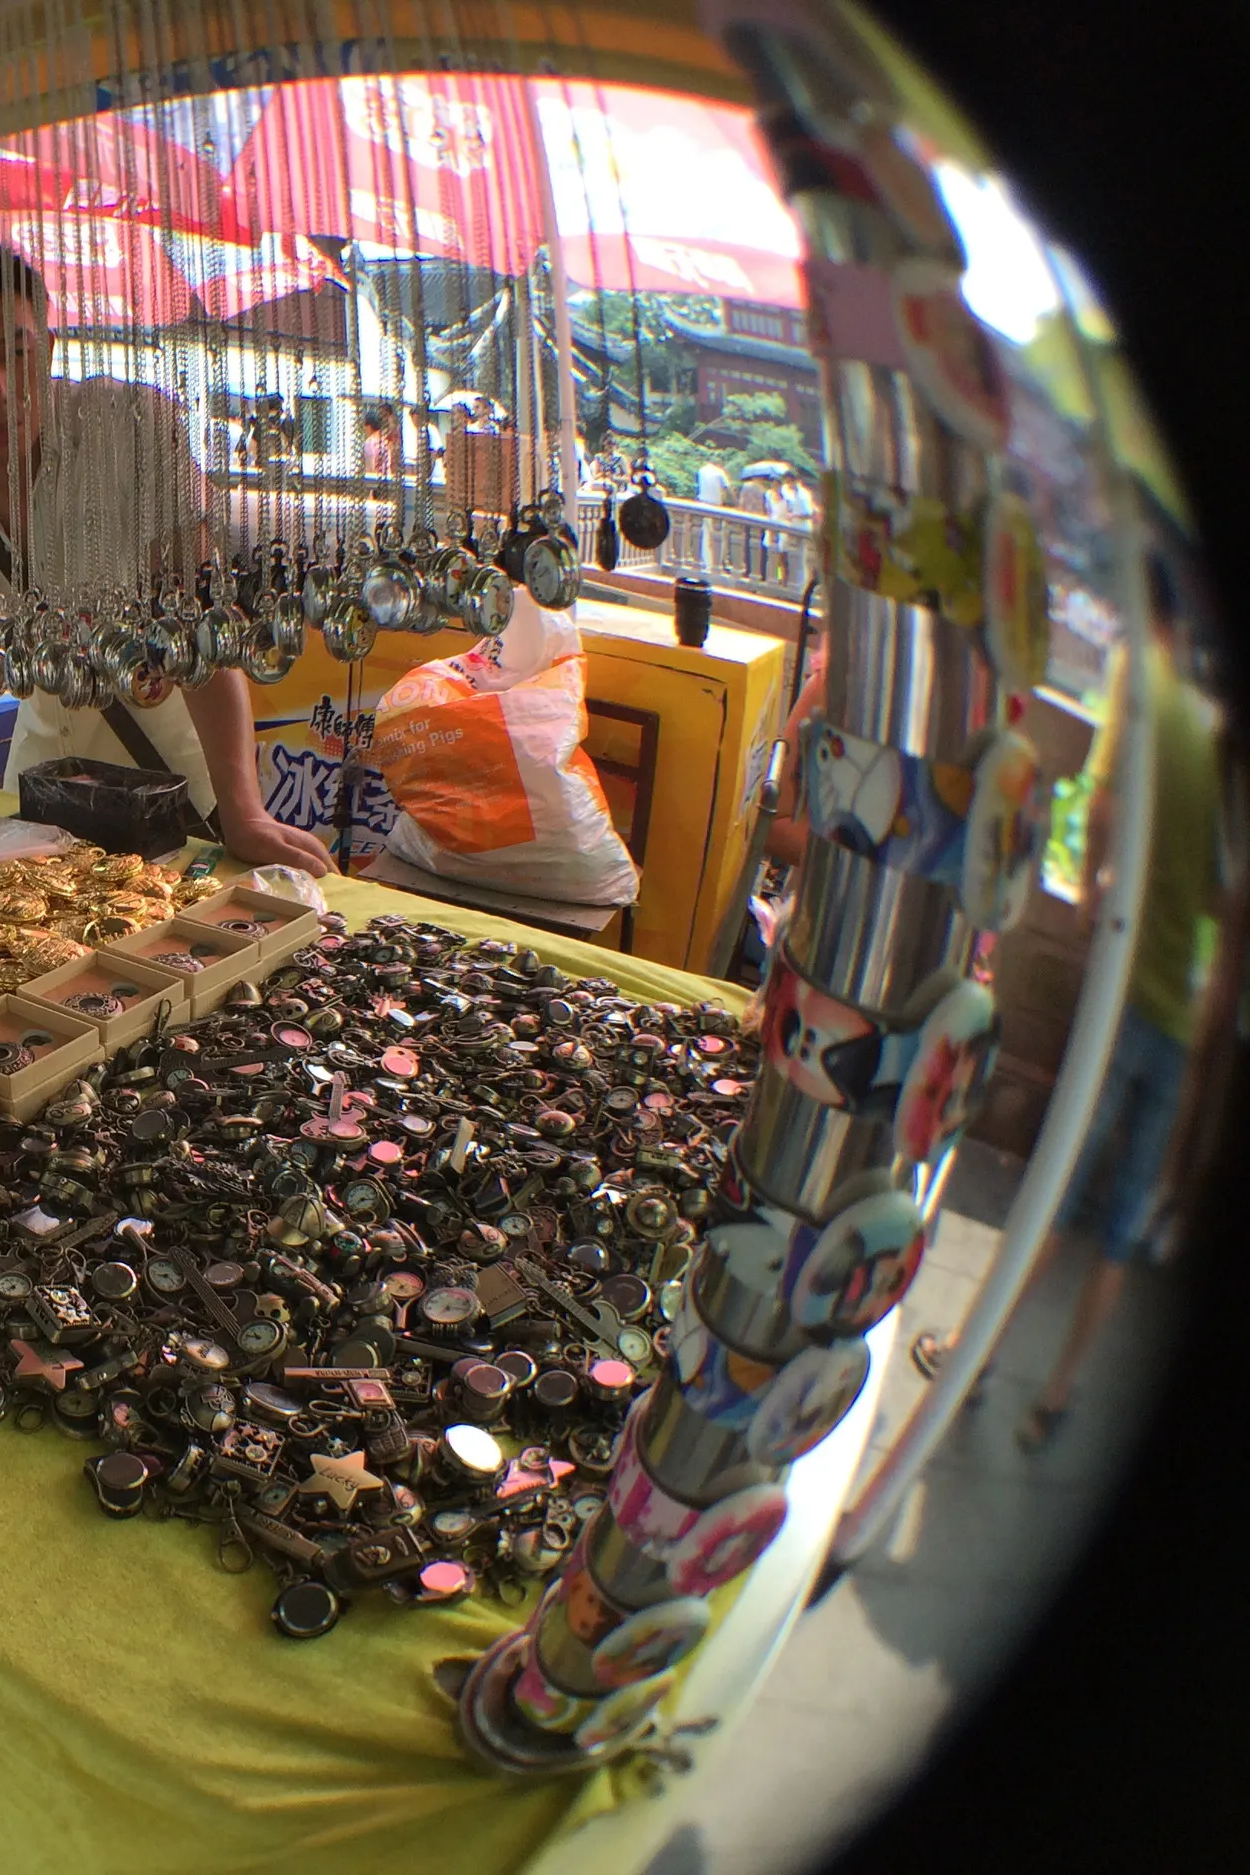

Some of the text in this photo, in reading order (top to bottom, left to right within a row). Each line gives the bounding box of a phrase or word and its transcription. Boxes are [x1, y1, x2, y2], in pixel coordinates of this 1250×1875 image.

[408, 718, 431, 735] for
[429, 726, 464, 748] Pigs
[318, 1467, 360, 1492] Lucky
